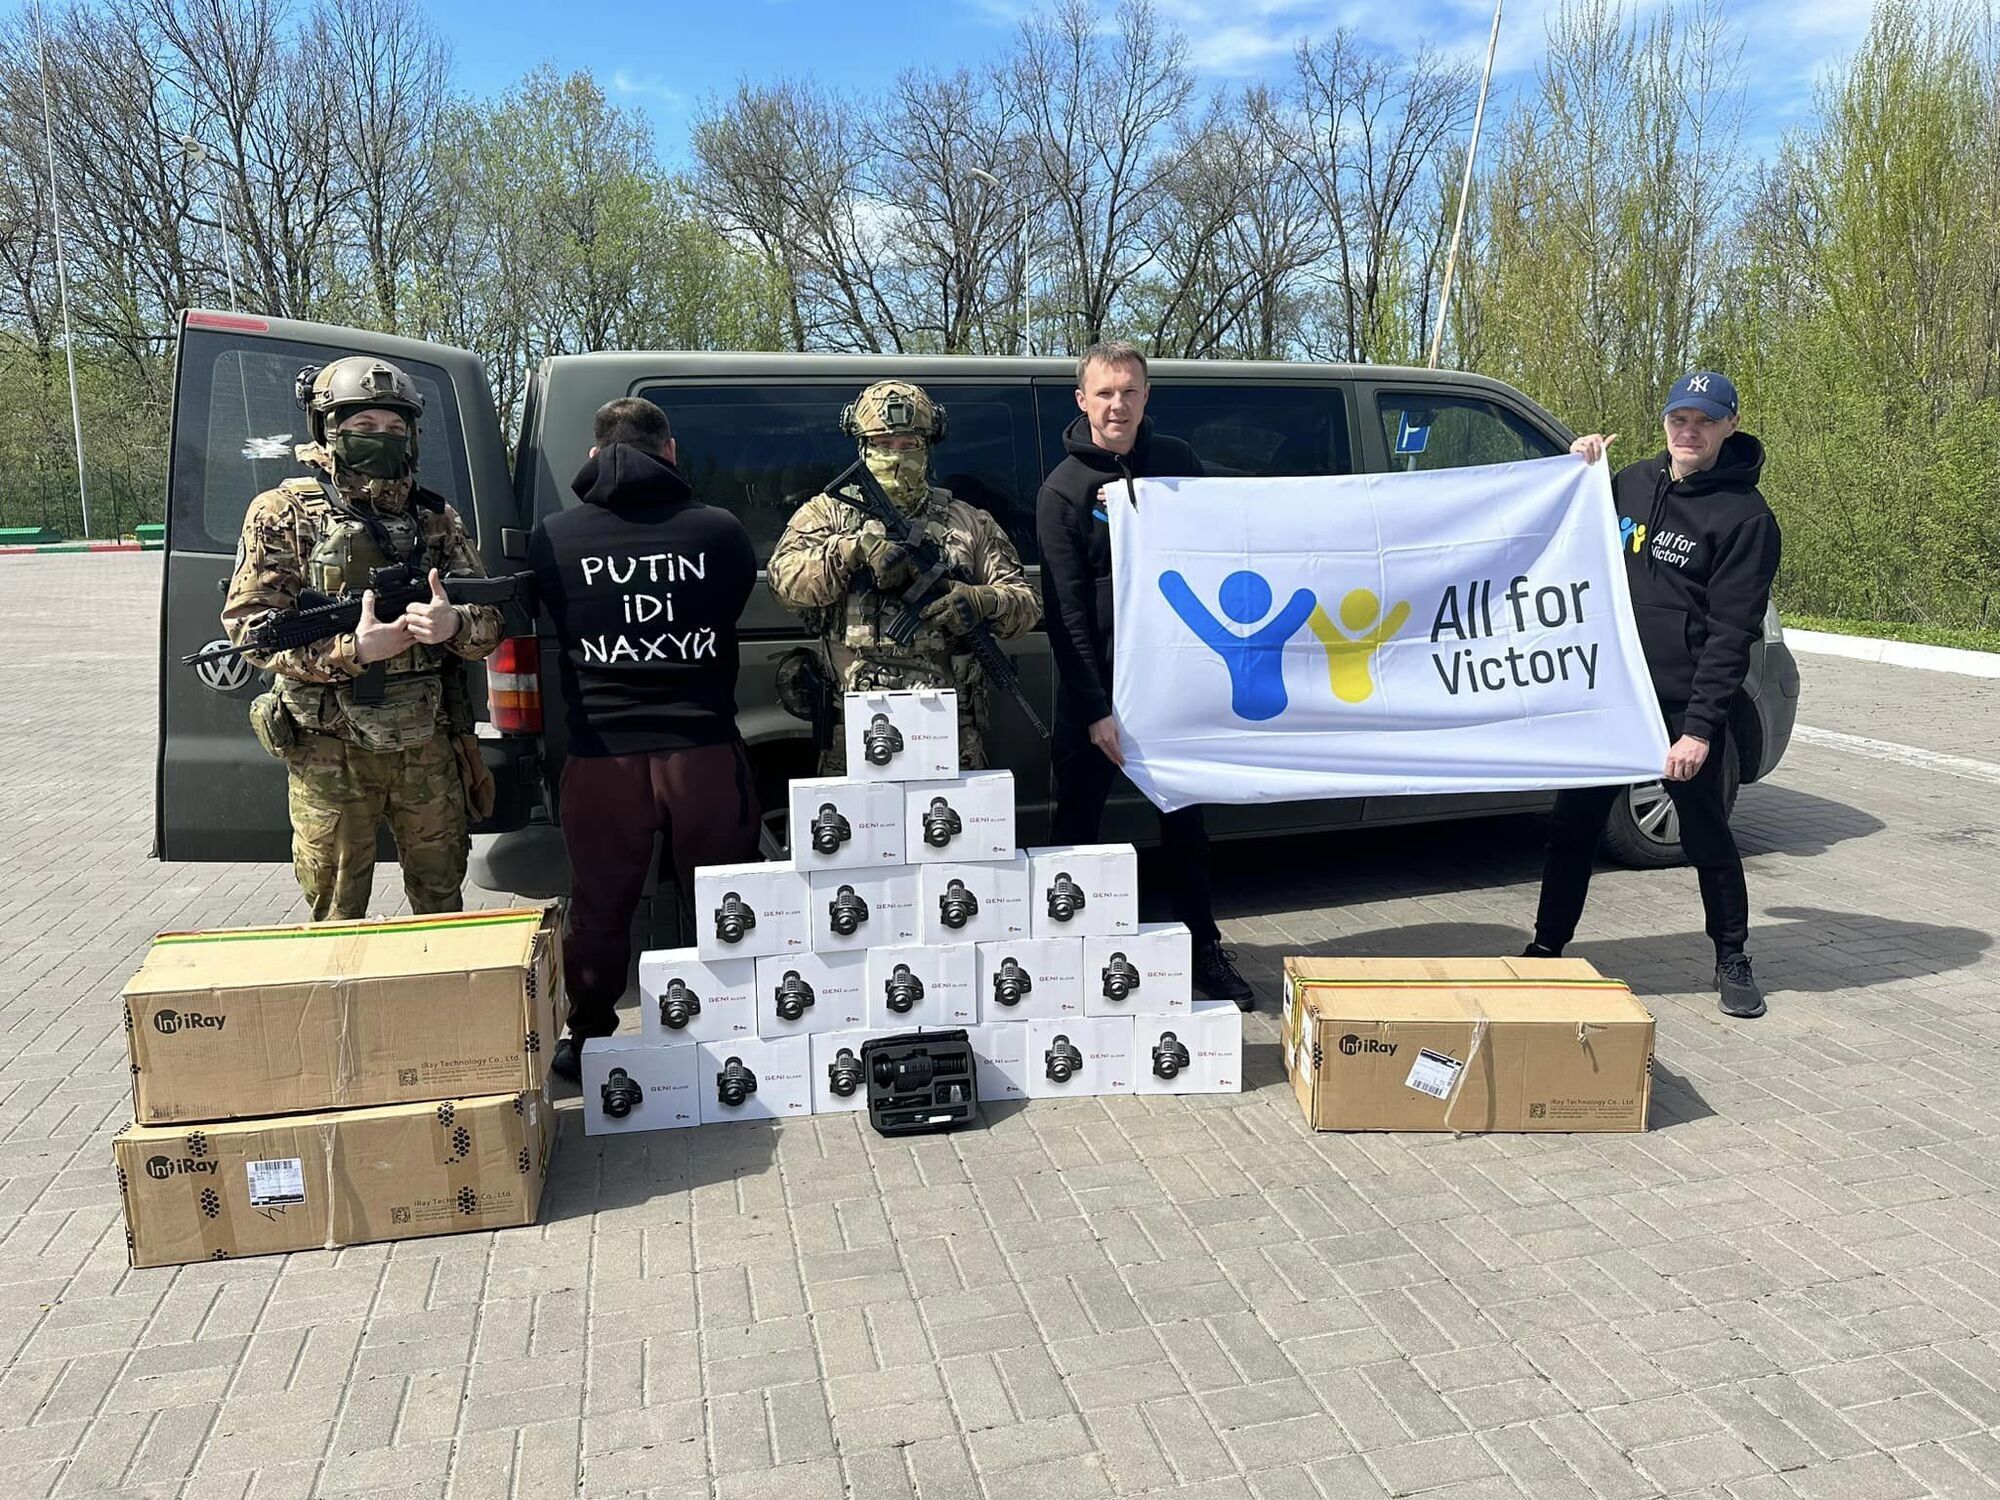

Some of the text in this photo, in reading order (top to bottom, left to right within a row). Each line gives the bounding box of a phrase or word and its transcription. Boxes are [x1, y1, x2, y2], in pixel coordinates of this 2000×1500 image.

[1652, 530, 1697, 553] All for
[1651, 544, 1689, 568] Victory
[1430, 575, 1590, 643] All for
[1432, 643, 1599, 695] Victory
[440, 1058, 487, 1068] Technology
[1567, 1098, 1605, 1107] Technology
